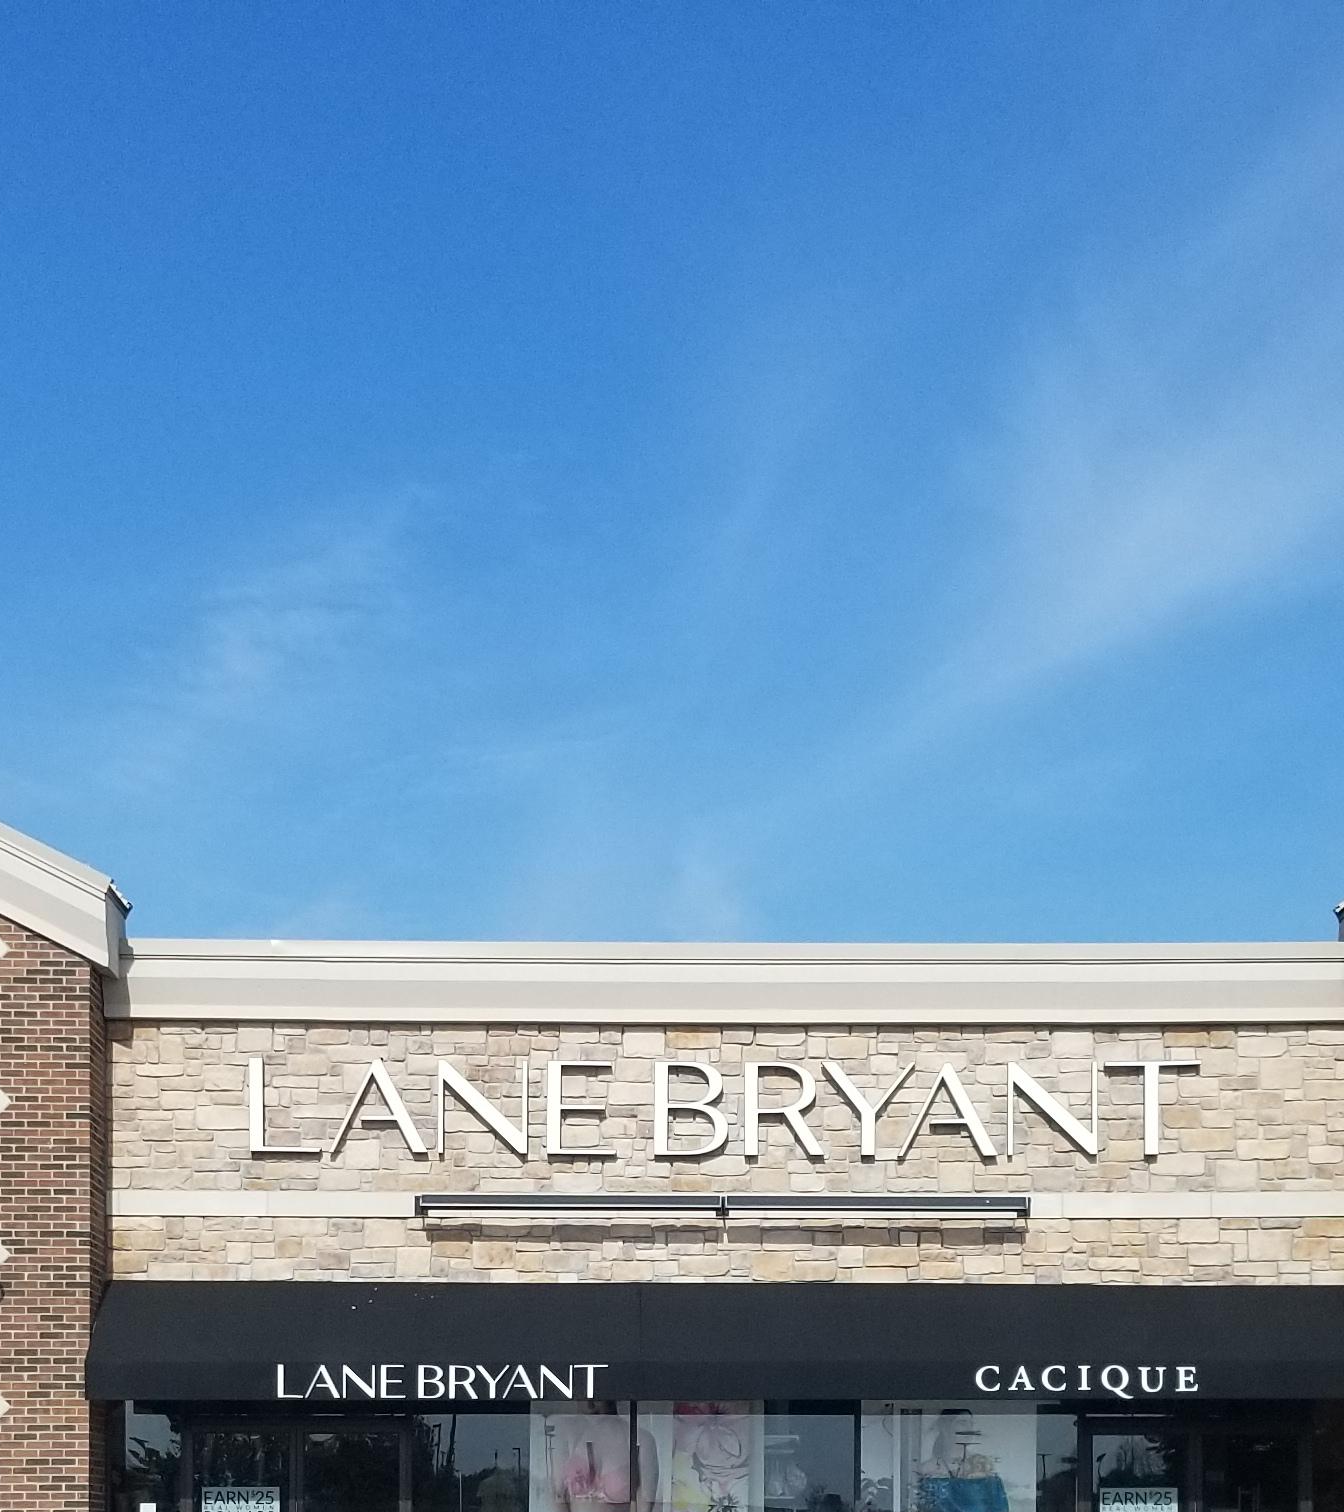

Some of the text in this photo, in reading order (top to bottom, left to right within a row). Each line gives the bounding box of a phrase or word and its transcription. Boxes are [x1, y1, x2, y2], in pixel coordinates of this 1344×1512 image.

[248, 1057, 1203, 1160] LANE BRYANT
[276, 1363, 609, 1400] LANE BRYANT
[975, 1364, 1199, 1400] CACIQUE
[204, 1491, 249, 1504] EARN
[1102, 1491, 1147, 1505] EARN
